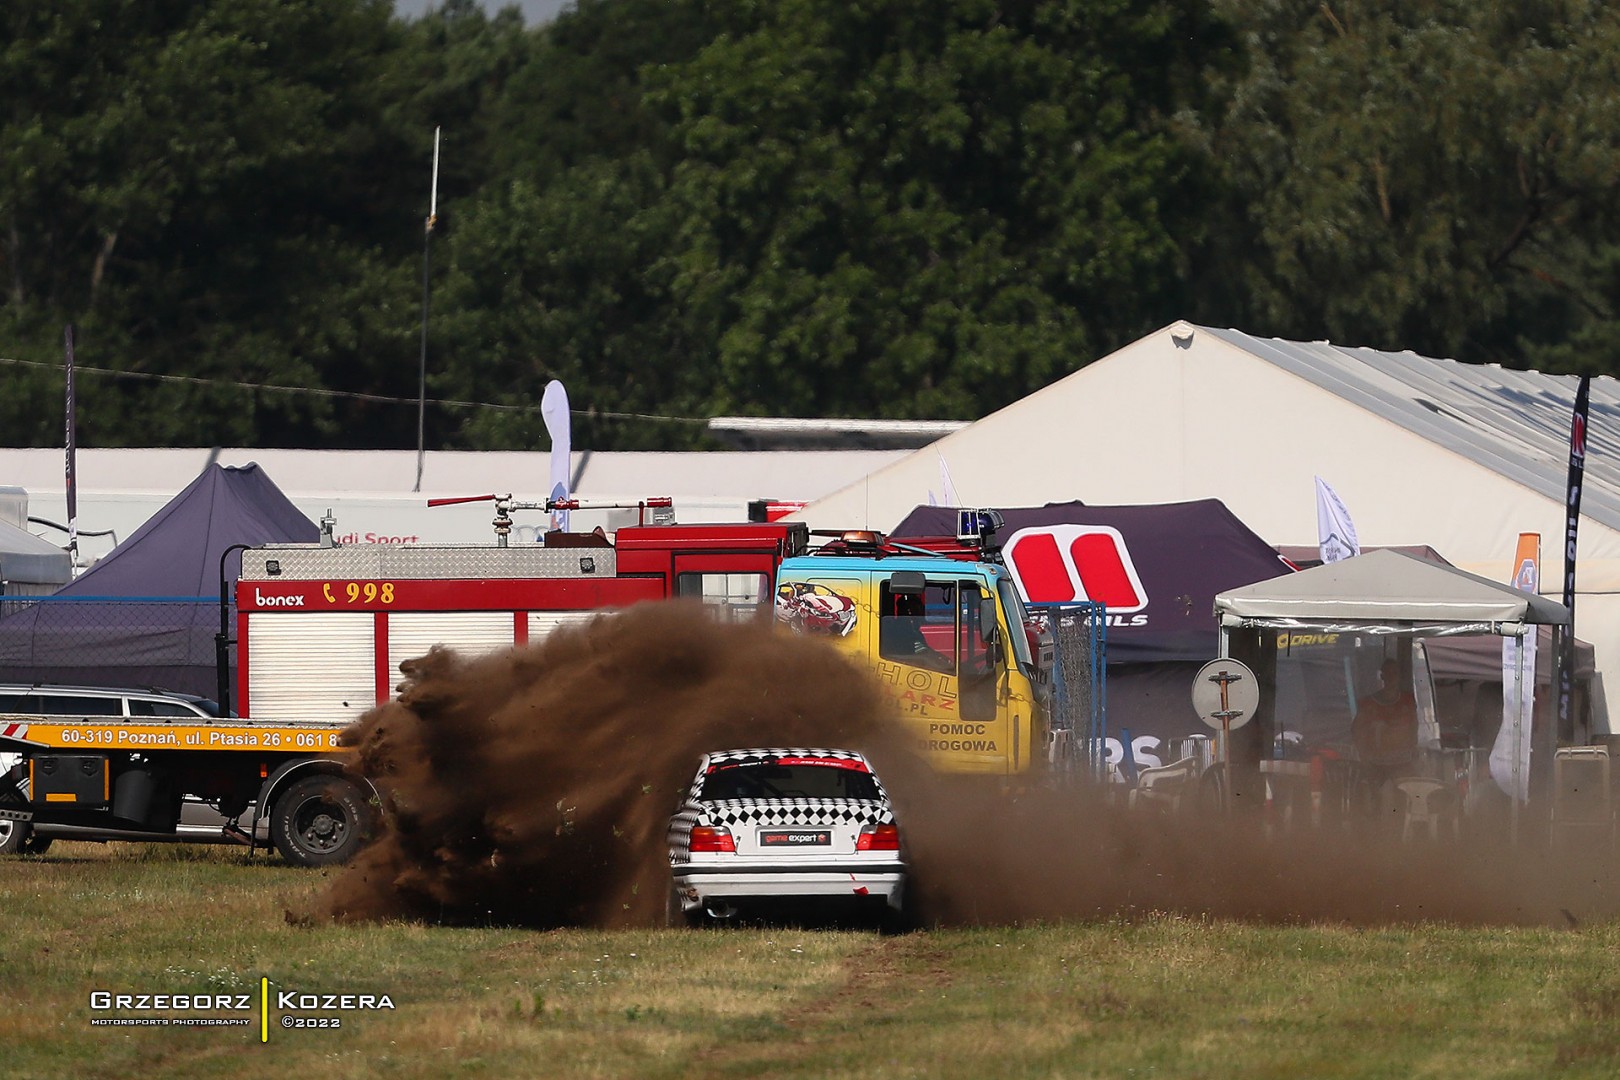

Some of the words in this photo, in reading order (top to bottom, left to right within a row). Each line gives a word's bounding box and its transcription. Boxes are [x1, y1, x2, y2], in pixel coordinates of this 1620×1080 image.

[255, 588, 305, 607] bonex
[346, 583, 395, 604] 998
[61, 729, 114, 743] 60-319
[118, 730, 182, 746] Poznań,
[185, 732, 205, 745] ul.
[209, 732, 258, 747] Ptasia
[262, 733, 281, 747] 26
[296, 733, 323, 747] 061
[929, 723, 986, 735] POMOC
[918, 740, 997, 752] DROGOWA
